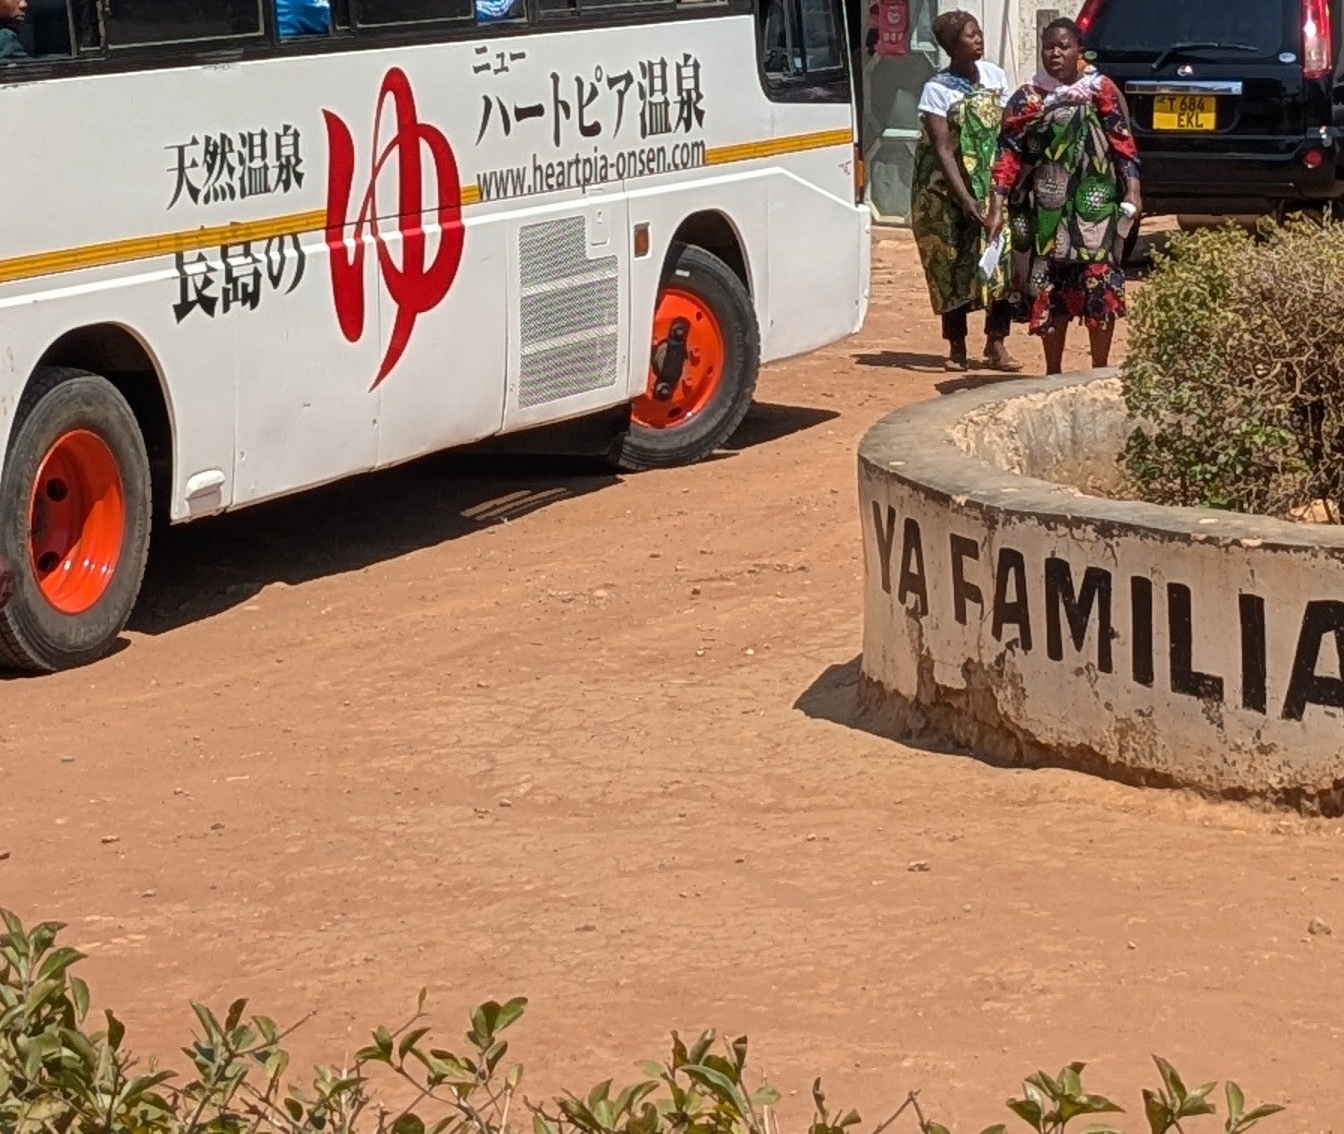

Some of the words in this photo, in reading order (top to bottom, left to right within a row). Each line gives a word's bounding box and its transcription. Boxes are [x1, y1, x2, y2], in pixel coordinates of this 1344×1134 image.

[473, 45, 527, 75] ニュー
[475, 53, 707, 147] ハートピア温泉
[1168, 97, 1176, 112] T
[1179, 97, 1205, 112] 684
[1178, 112, 1204, 128] EKL
[164, 123, 304, 211] 天然温泉
[477, 137, 707, 201] www.heartpia-onsen.com
[322, 67, 465, 393] ゆ
[870, 500, 928, 617] YA
